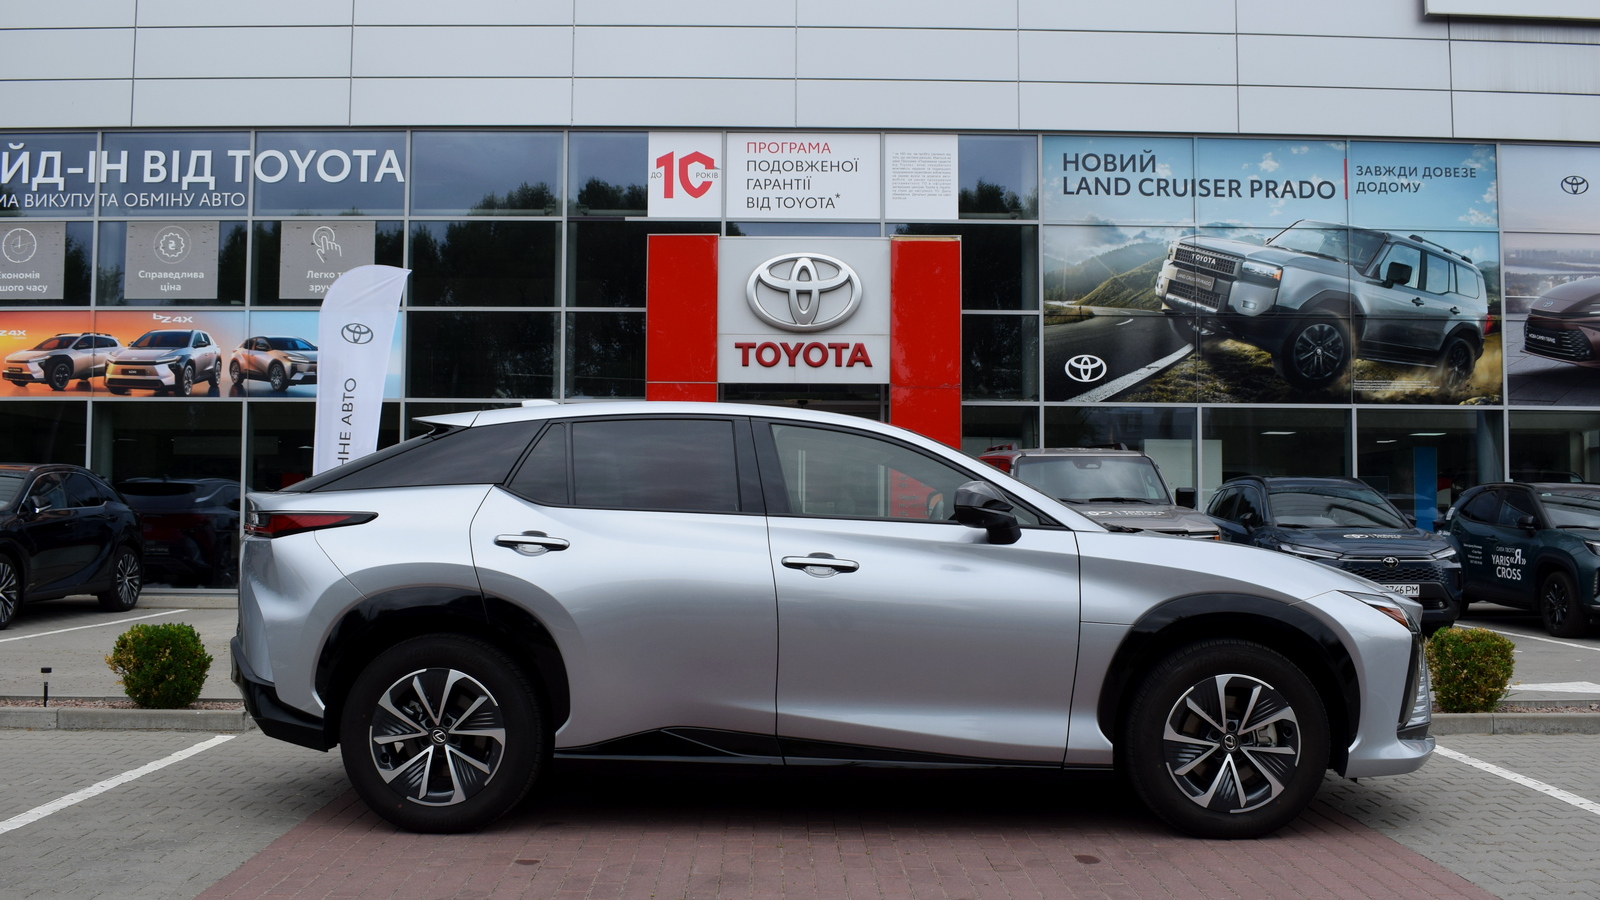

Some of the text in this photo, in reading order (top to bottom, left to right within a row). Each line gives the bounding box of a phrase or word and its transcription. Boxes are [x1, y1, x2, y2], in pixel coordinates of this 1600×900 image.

[746, 142, 832, 154] ПРОГРАМА
[746, 157, 860, 174] ПОДОВЖЕНОЇ
[1062, 149, 1157, 174] НОВИЙ
[143, 150, 216, 191] ВІД
[227, 149, 405, 183] TOYOTA
[650, 171, 663, 179] ДО
[1355, 165, 1477, 180] ЗАВЖДИ ДОВЕЗЕ
[746, 175, 812, 190] ГАРАНТІЇ
[1062, 176, 1336, 200] LAND CRUISER PRADO
[1355, 181, 1421, 195] ДОДОМУ
[24, 193, 95, 208] ВИКУПУ
[99, 193, 119, 207] ТА
[123, 192, 195, 208] ОБМІНУ
[199, 192, 246, 207] АВТО
[746, 196, 772, 211] ВІД
[1191, 253, 1216, 265] TOYOTA
[138, 270, 205, 281] Справедлива
[306, 270, 336, 279] Легко
[26, 285, 48, 293] часу
[160, 282, 182, 293] ціна
[734, 341, 873, 368] TOYOTA
[341, 377, 357, 426] АВТО
[1491, 554, 1510, 567] YARIS
[1496, 566, 1522, 581] CROSS
[1385, 585, 1418, 594] 746 PM
